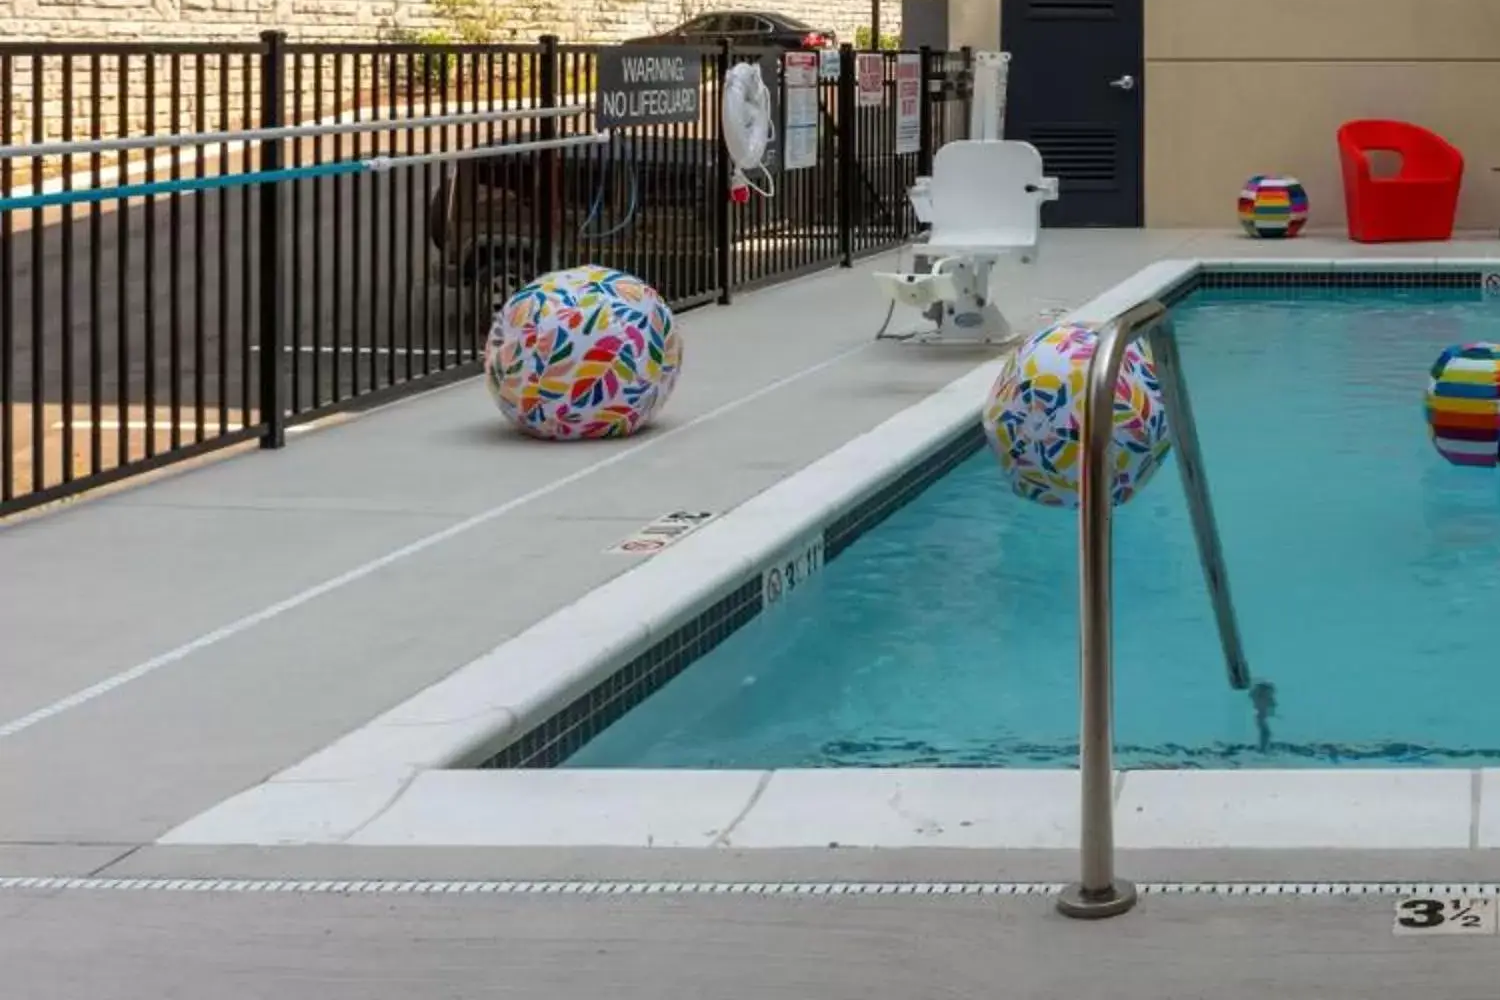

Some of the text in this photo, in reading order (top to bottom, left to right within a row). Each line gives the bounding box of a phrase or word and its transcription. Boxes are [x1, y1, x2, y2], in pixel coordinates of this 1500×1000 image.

[621, 56, 685, 84] WARNING
[603, 88, 697, 118] NO LIFEGUARD
